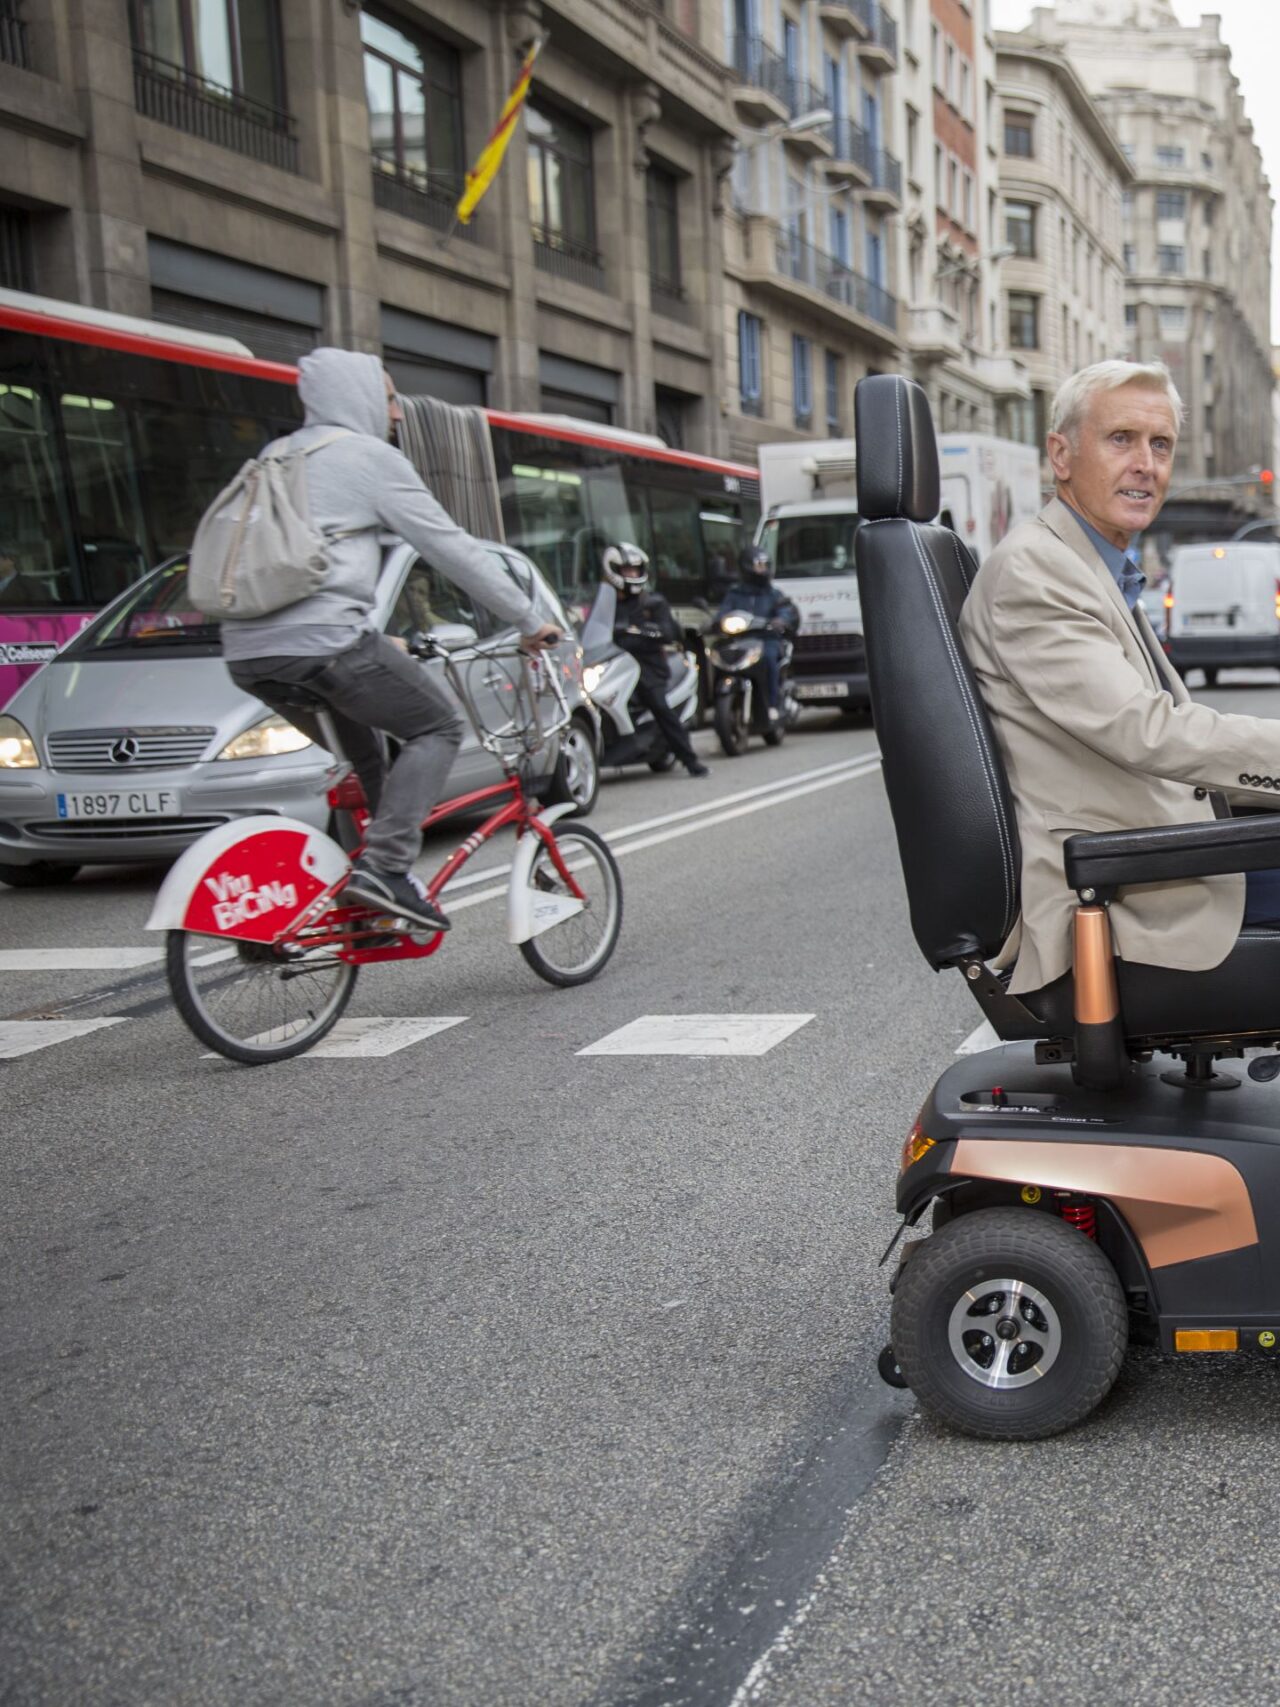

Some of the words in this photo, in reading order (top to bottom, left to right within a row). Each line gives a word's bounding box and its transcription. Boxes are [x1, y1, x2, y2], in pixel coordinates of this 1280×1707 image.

[71, 794, 120, 816] 1897
[128, 792, 171, 814] CLF
[204, 871, 253, 902] Viu
